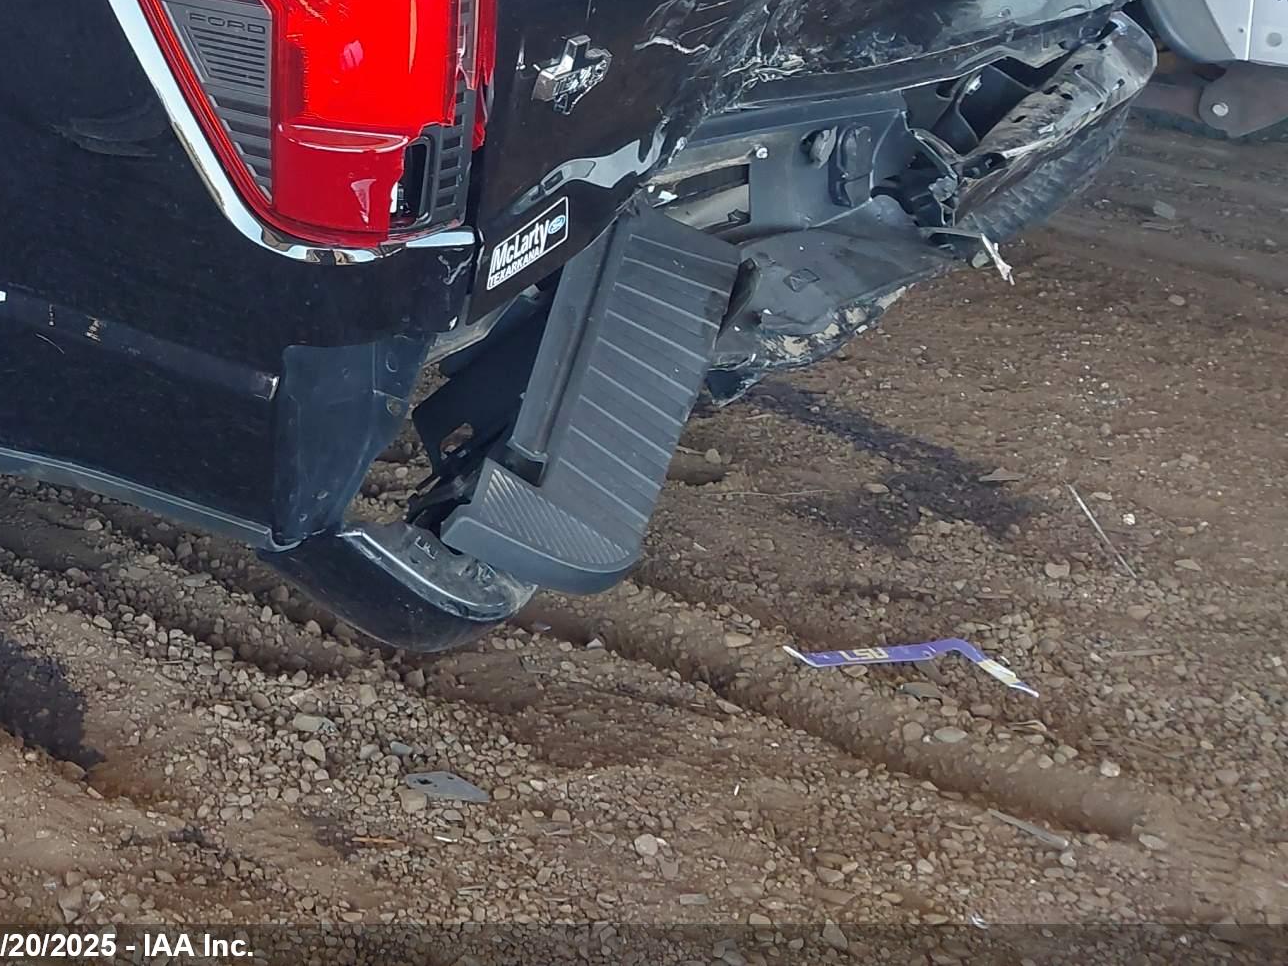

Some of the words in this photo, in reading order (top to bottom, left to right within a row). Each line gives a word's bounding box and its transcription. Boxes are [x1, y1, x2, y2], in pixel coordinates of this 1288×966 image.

[189, 13, 266, 35] FORD
[492, 219, 550, 274] McLarty
[488, 246, 542, 288] TEXARKANA
[838, 647, 889, 662] LSU
